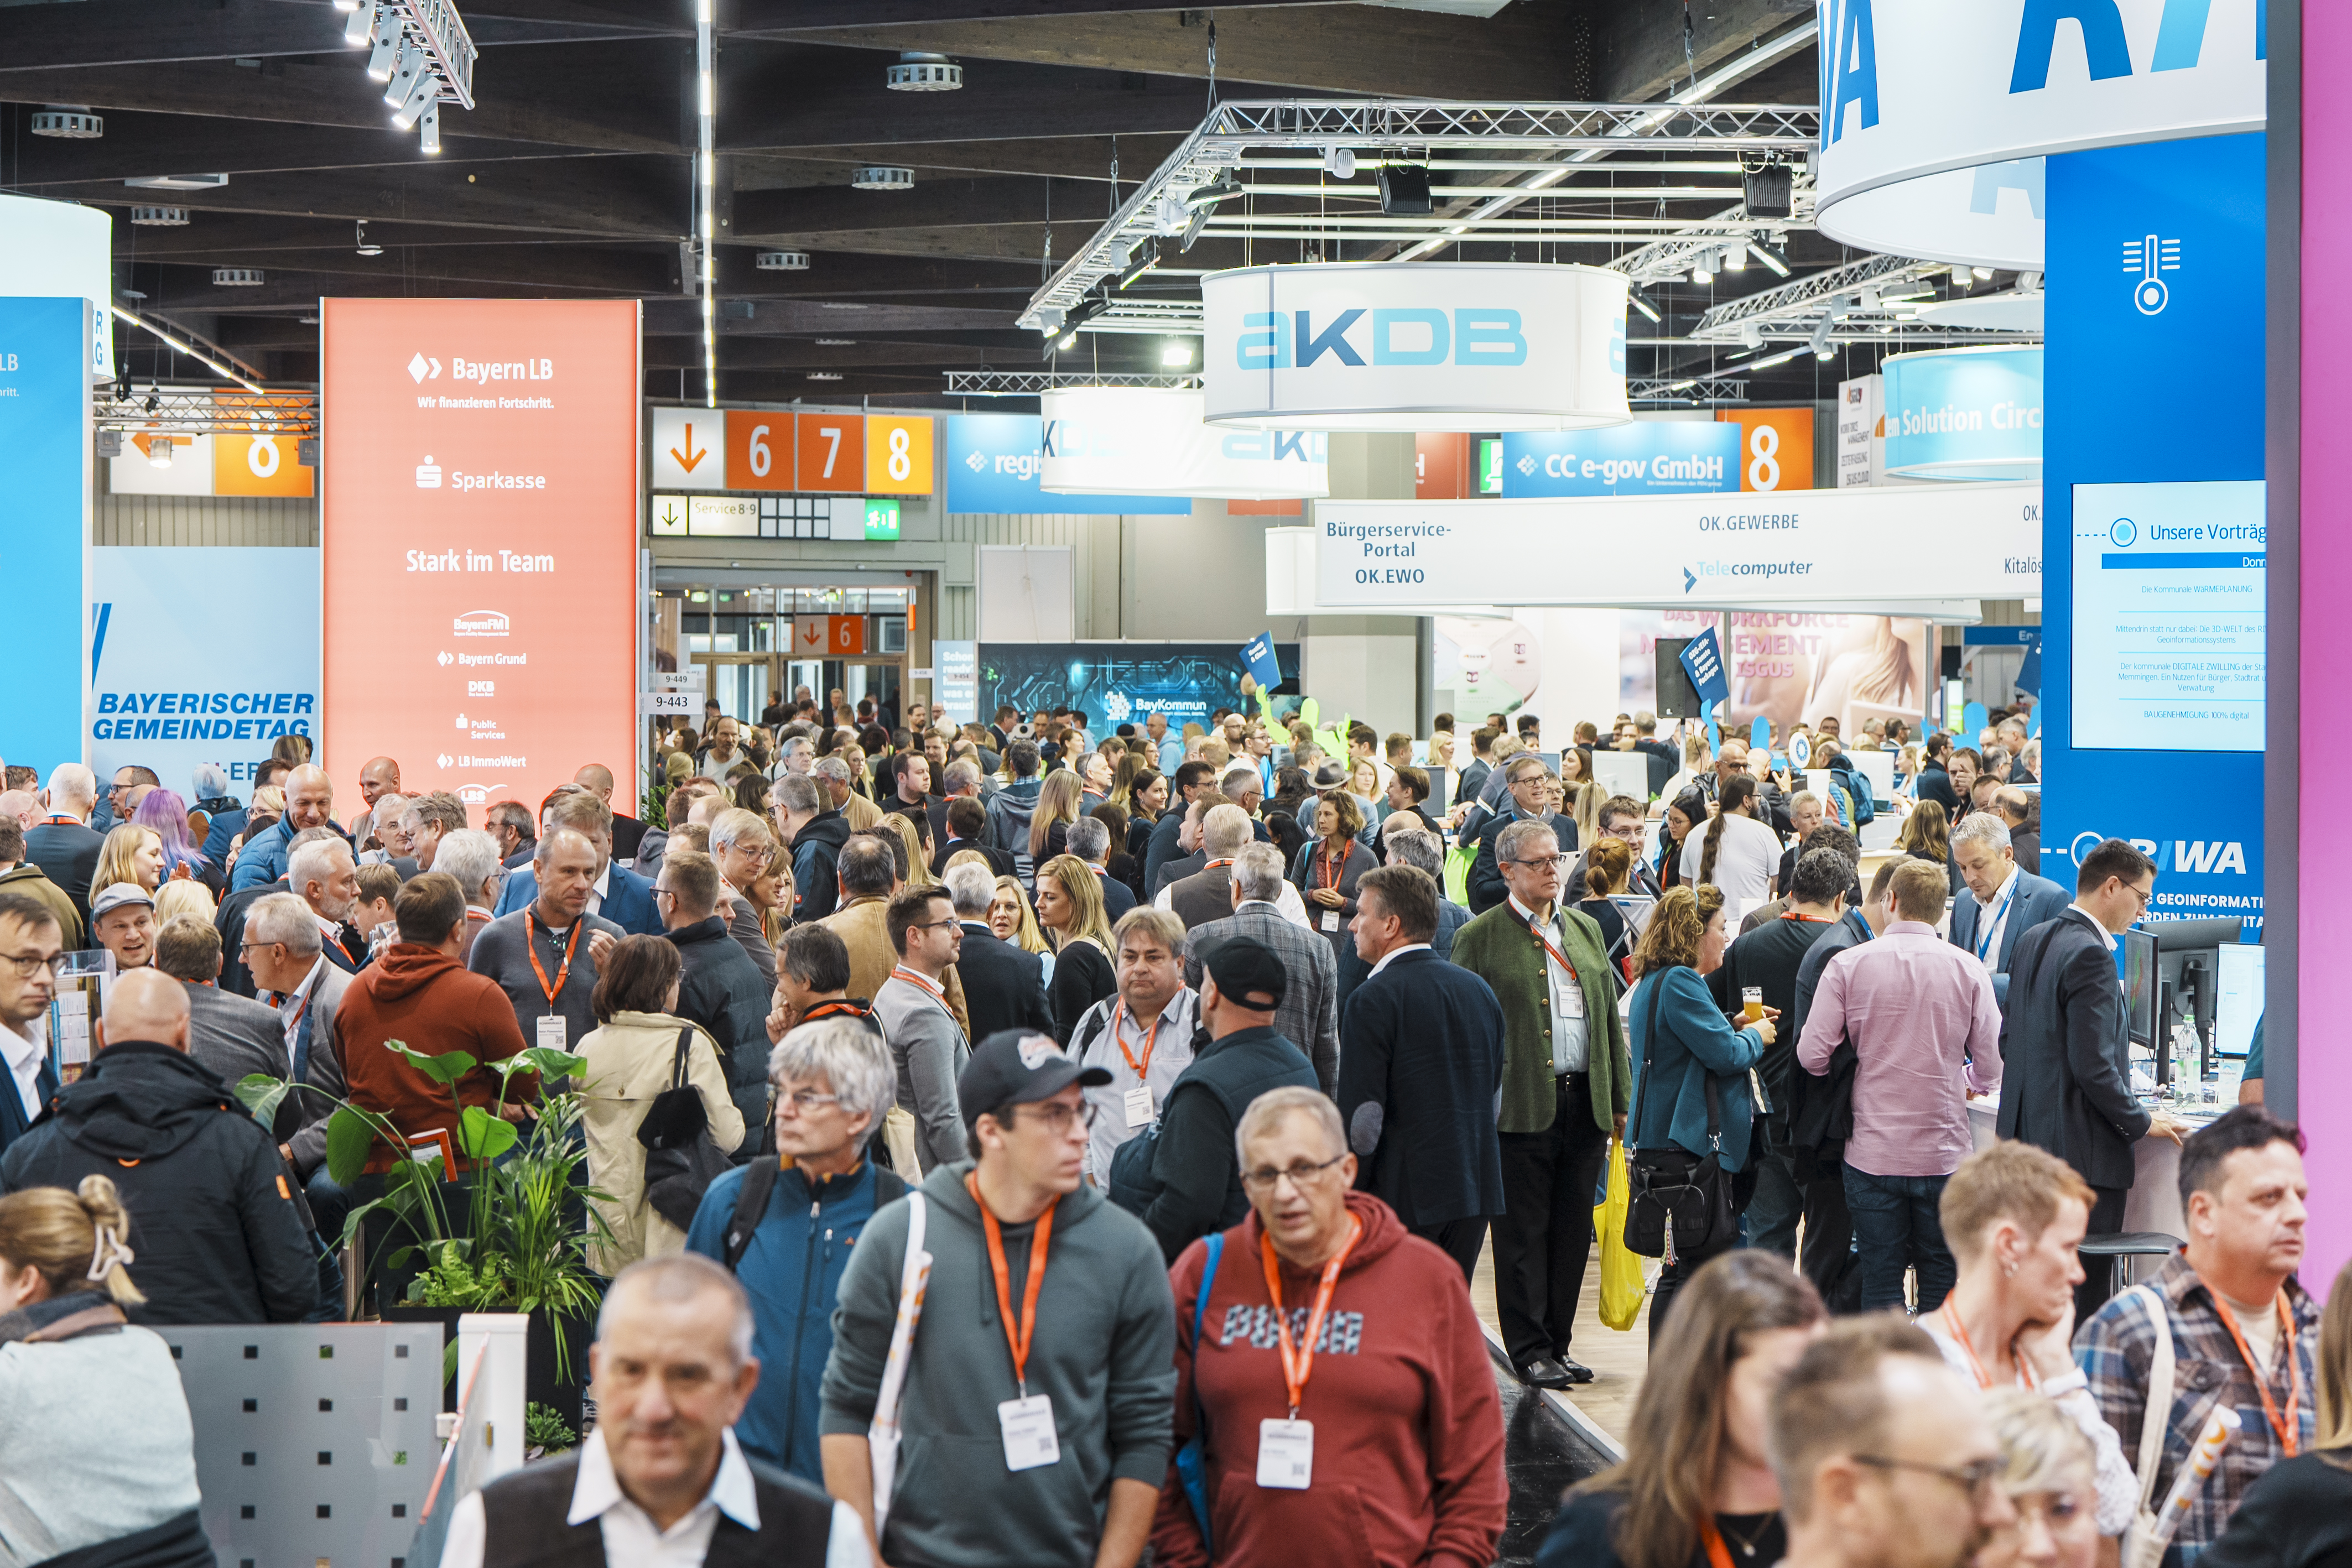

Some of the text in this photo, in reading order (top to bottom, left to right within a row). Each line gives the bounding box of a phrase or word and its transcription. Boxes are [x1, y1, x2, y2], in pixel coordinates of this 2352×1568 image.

[1236, 308, 1528, 370] aKDB
[453, 357, 553, 385] Bayern LB
[417, 396, 554, 409] Wir finanzieren Fortschritt.
[1903, 404, 1982, 436] Solution
[748, 424, 772, 478] 6
[820, 427, 842, 478] 7
[888, 427, 911, 481] 8
[1748, 424, 1780, 492] 8
[1544, 454, 1723, 485] CC e-gov GmbH
[451, 471, 546, 492] Sparkasse
[694, 502, 736, 514] Service
[1326, 521, 1451, 540] Bürgerservice-
[1699, 514, 1799, 531] OK.GEWERBE
[2150, 524, 2266, 543] Unsere Vorträg
[1364, 541, 1415, 557] Portal
[406, 548, 554, 572] Stark im Team
[1355, 568, 1424, 584] OK.EWO
[1697, 560, 1813, 579] Telecomputer
[454, 618, 504, 632] BayernFM
[839, 622, 851, 647] 6
[2157, 636, 2236, 645] Geoinformationssystems
[459, 652, 527, 667] Bayern Grund
[1736, 661, 1794, 678] ISGUS
[468, 680, 495, 692] DKB
[2118, 673, 2160, 682] Memmingen.
[2208, 674, 2233, 683] Bürger,
[943, 690, 963, 698] was
[2178, 684, 2214, 693] Verwaltung
[98, 692, 314, 714] BAYERISCHER
[656, 696, 688, 707] 9-443
[1136, 698, 1206, 713] BayKommun
[2230, 711, 2249, 721] digital
[92, 718, 309, 739] GEMEINDETAG
[471, 720, 497, 729] Public
[471, 731, 506, 739] Services
[458, 756, 527, 767] LB ImmoWert
[460, 790, 486, 802] LBS
[2156, 893, 2265, 909] GEOINFORMATI
